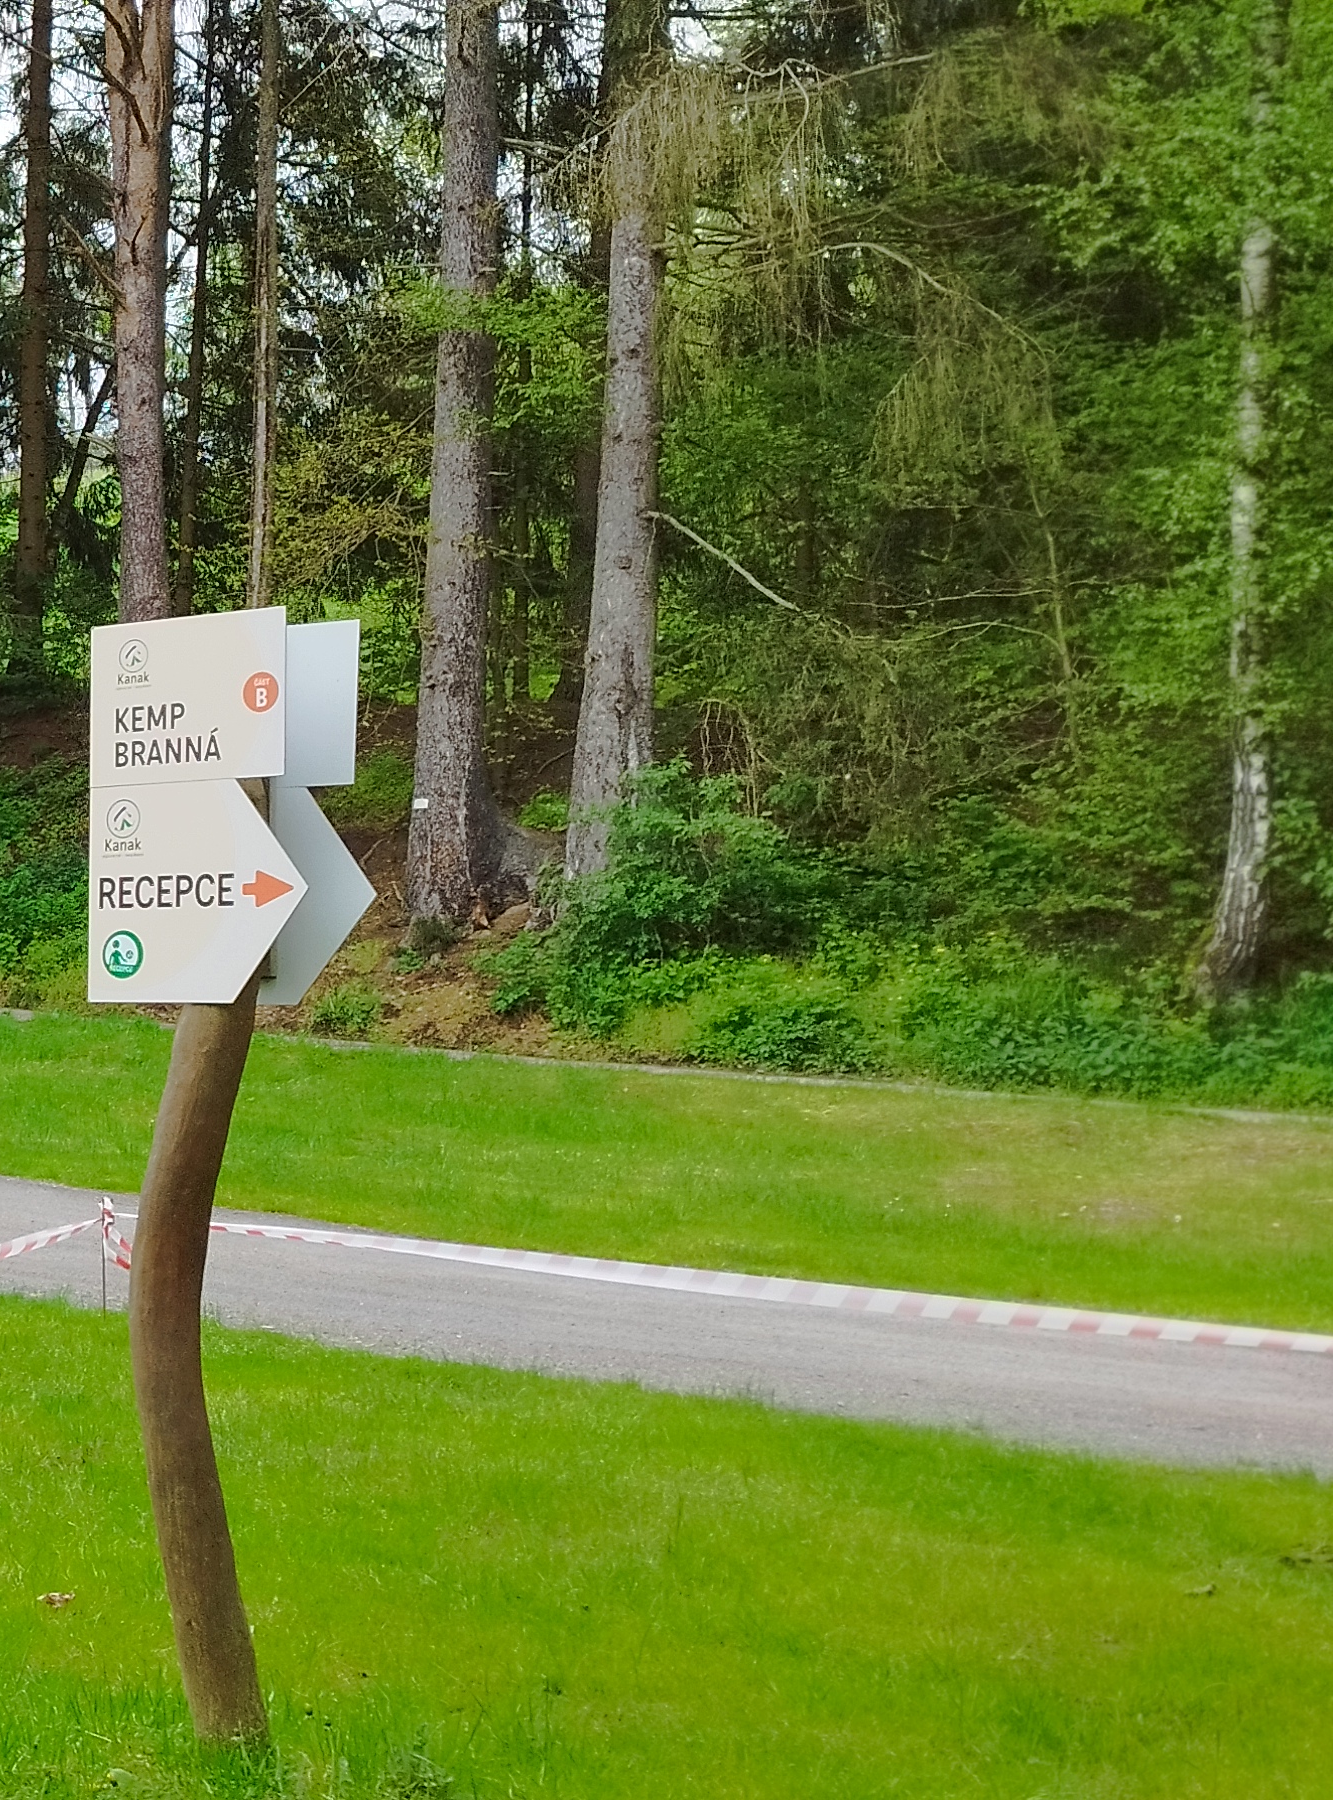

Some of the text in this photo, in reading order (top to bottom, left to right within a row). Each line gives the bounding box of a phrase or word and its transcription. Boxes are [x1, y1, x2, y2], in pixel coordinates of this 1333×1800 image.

[117, 671, 149, 685] Kanak
[256, 687, 268, 707] B
[115, 702, 185, 734] KEMP
[115, 727, 221, 768] BRANNÁ
[104, 837, 142, 852] Kanak
[98, 873, 235, 909] RECEPCE
